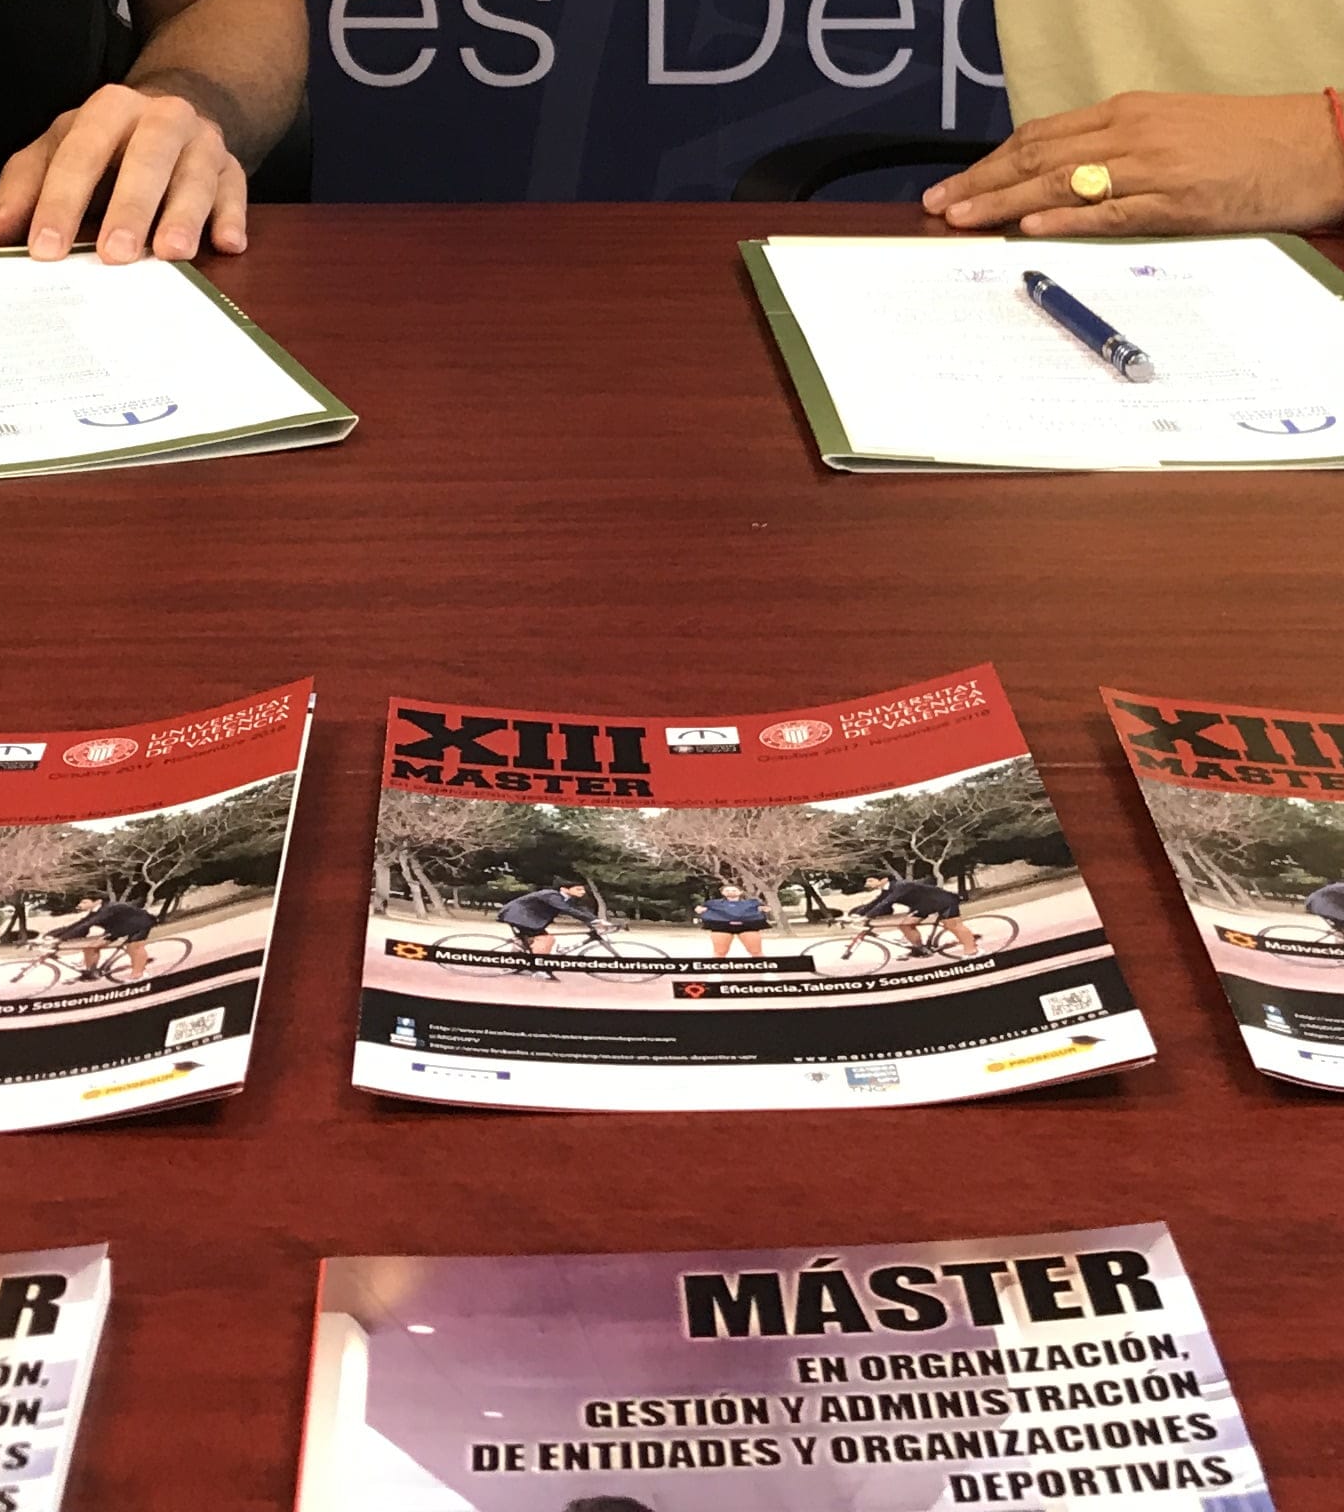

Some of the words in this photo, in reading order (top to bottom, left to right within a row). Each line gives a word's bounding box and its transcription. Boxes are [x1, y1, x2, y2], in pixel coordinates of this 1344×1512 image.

[839, 679, 978, 722] UNIVERSITAT
[395, 708, 650, 774] XIII
[391, 759, 653, 797] MASTER
[435, 950, 531, 967] Motivación,
[535, 957, 675, 972] Emprededurismo
[678, 962, 689, 973] y
[692, 959, 778, 971] Excelencia
[866, 979, 876, 990] y
[879, 958, 995, 988] Sostenibilidad
[17, 1005, 29, 1016] y
[32, 982, 151, 1011] Sostenibilidad
[683, 1249, 1166, 1338] MÁSTER
[797, 1356, 848, 1383] EN
[860, 1331, 1190, 1382] ORGANIZACIÓN,
[585, 1392, 770, 1428] GESTIÓN
[780, 1396, 805, 1424] Y
[820, 1369, 1202, 1423] ADMINISTRACIÓN
[472, 1443, 526, 1472] DE
[538, 1438, 782, 1471] ENTIDADES
[791, 1436, 818, 1466] Y
[831, 1412, 1218, 1464] ORGANIZACIONES
[949, 1455, 1233, 1504] DEPORTIVAS
